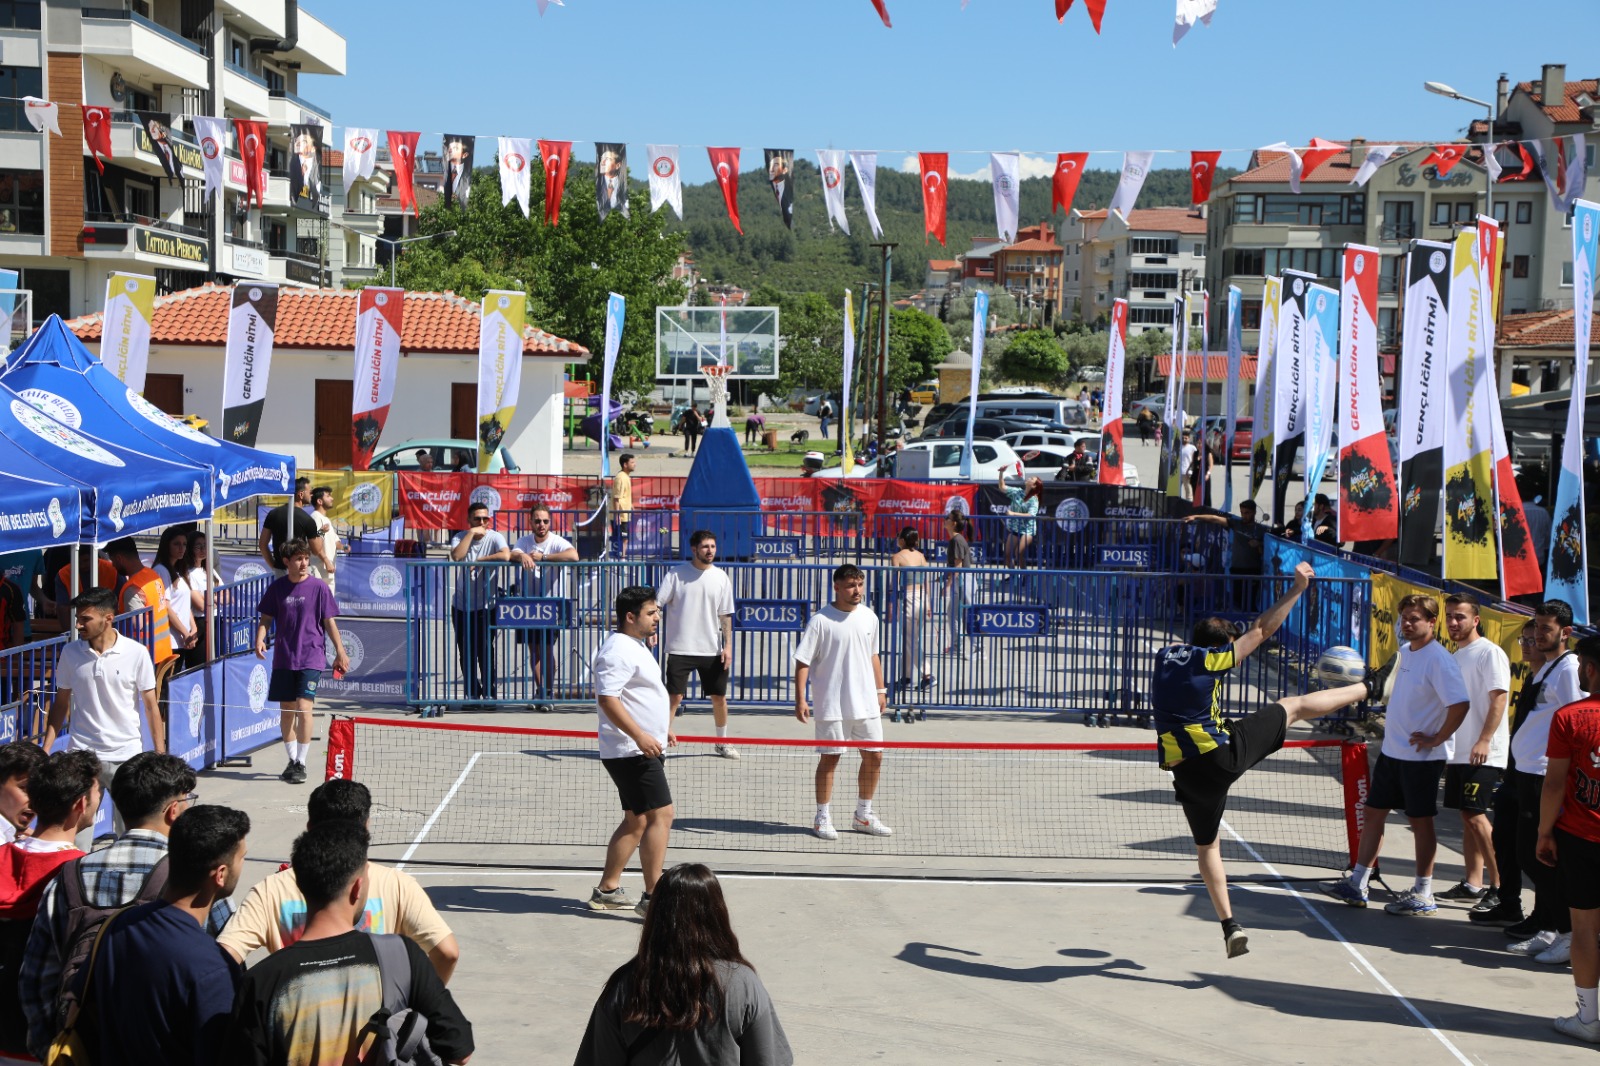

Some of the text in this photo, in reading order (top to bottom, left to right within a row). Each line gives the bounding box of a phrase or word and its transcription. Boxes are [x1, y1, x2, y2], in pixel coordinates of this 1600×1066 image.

[176, 237, 202, 261] PIERCING
[121, 304, 133, 335] RİTMİ
[496, 321, 506, 351] RİTMİ
[243, 313, 257, 399] GENÇLİĞİN RİTMİ
[371, 317, 384, 403] GENÇLİĞİN RİTMİ
[1350, 294, 1360, 431] GENÇLİĞİN RİTMİ
[1287, 313, 1300, 432] GENÇLİĞİN RİTMİ
[1417, 295, 1438, 445] GENÇLİĞİN RİTMİ
[407, 489, 462, 502] GENÇLİĞİN
[516, 491, 573, 502] GENÇLİĞİN
[761, 496, 812, 508] GENÇLİĞİN
[878, 498, 931, 510] GENÇLİĞİN
[422, 501, 451, 513] RİTMİ
[10, 508, 50, 530] BELEDİYESİ
[755, 540, 793, 555] POLİS
[499, 603, 553, 621] POLİS
[743, 602, 798, 623] POLİS
[981, 611, 1036, 629] POLİS
[361, 682, 403, 695] BELEDİYESİ
[1464, 782, 1480, 796] 27
